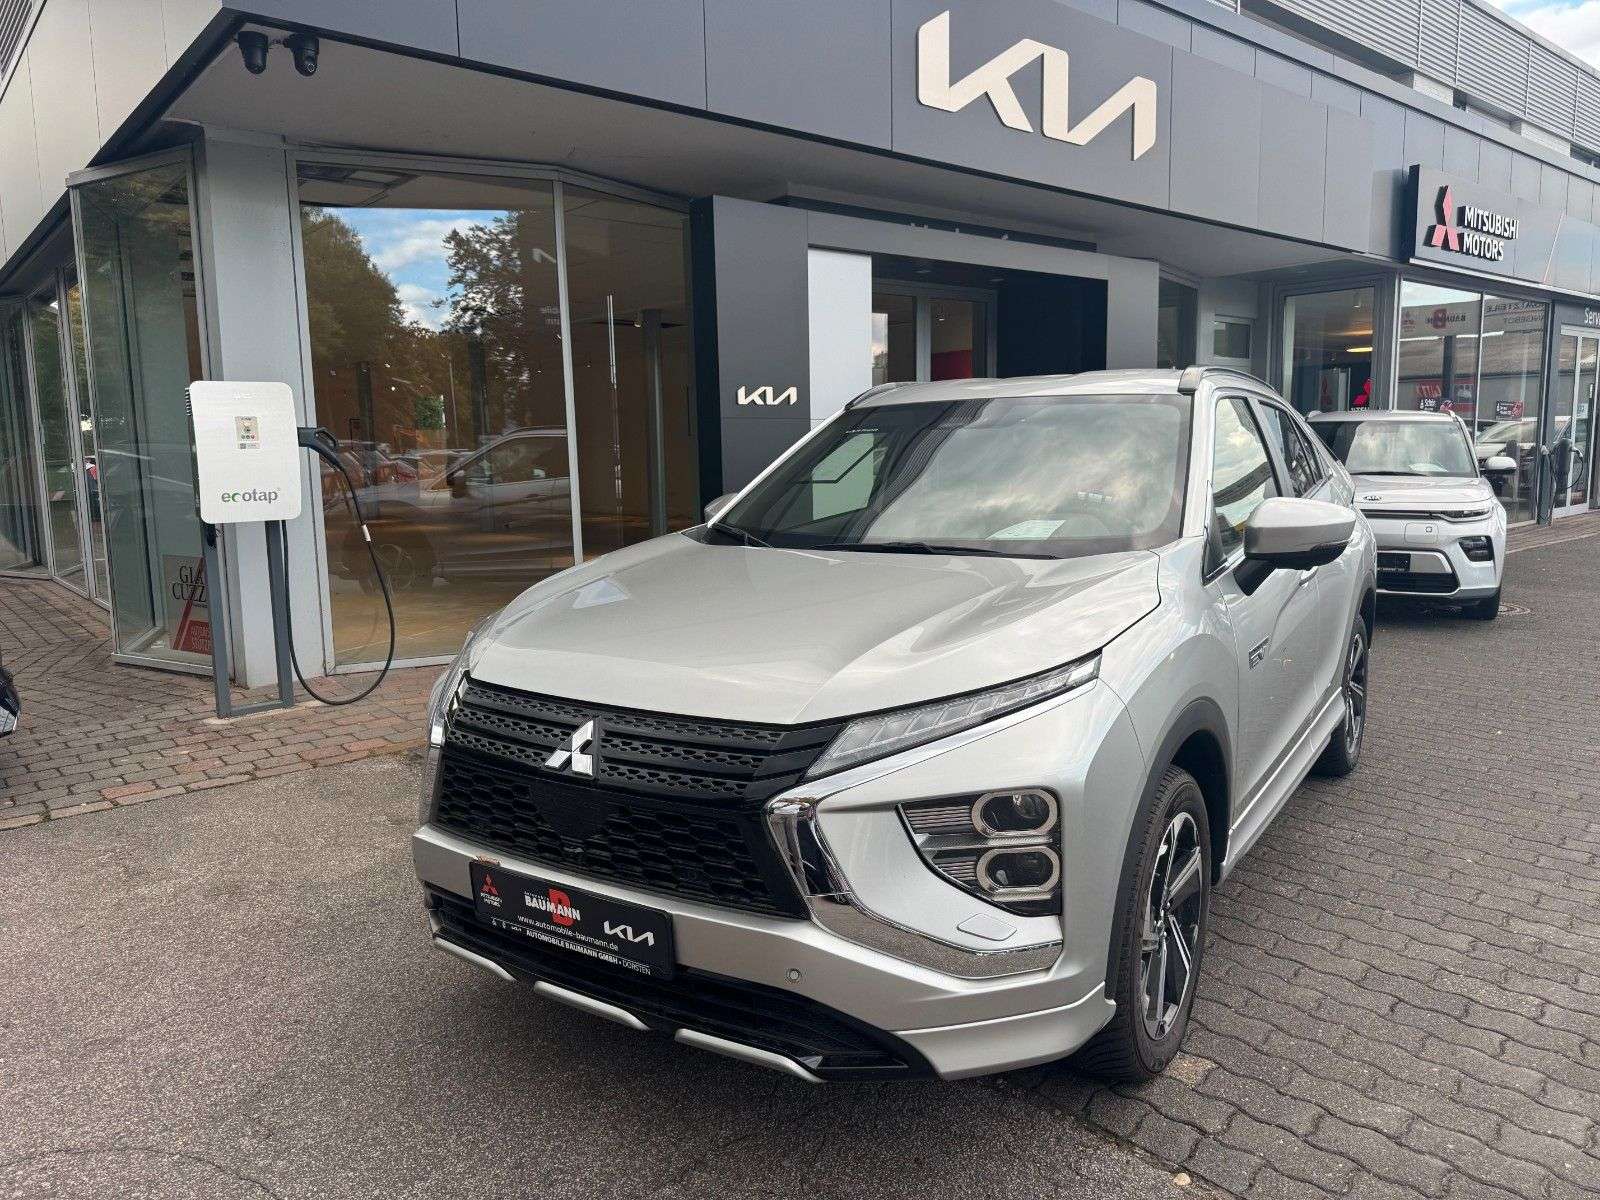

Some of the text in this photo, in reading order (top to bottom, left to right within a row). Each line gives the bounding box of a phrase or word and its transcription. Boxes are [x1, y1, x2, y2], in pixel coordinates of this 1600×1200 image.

[917, 10, 1157, 161] KIA
[1464, 205, 1519, 240] MITSUBISHI
[1462, 232, 1504, 261] MOTORS
[737, 386, 798, 405] KIA
[221, 488, 278, 504] ecotap
[525, 894, 581, 921] BAUMANN
[517, 914, 620, 951] www.automobile-baumann.de
[603, 920, 655, 947] KIA
[526, 929, 565, 949] AUTOMOBILE
[565, 941, 599, 959] BAUMANN
[622, 959, 652, 976] DORSTEN
